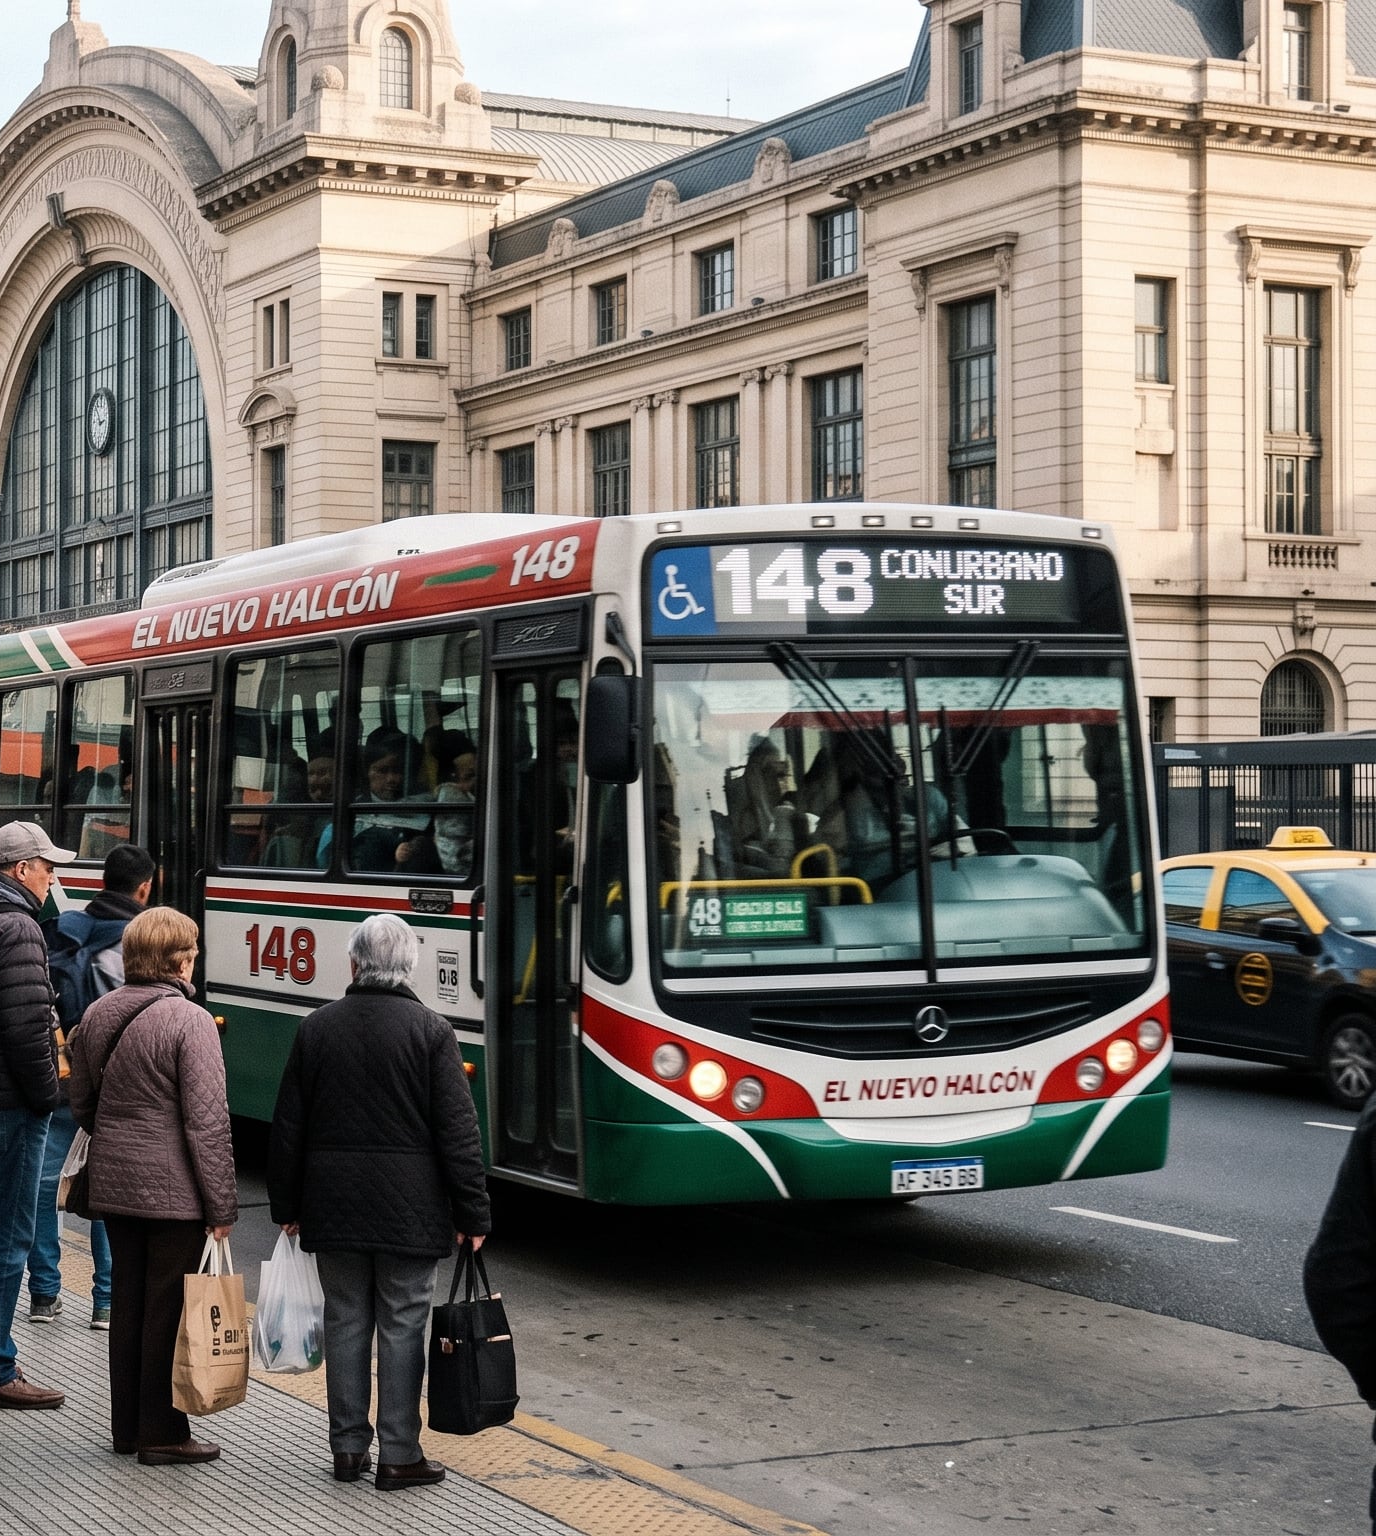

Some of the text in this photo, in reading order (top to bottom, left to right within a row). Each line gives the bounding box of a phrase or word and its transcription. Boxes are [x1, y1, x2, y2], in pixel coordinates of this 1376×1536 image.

[510, 536, 580, 586] 148
[716, 547, 874, 615] 148
[880, 548, 1064, 582] CONURBANO
[131, 566, 401, 650] EL NUEVO HALCÓN
[943, 584, 1005, 615] SUR
[245, 923, 317, 985] 148
[823, 1066, 1037, 1103] EL NUEVO HALCÓN
[896, 1171, 917, 1191] AF
[922, 1169, 953, 1189] 345
